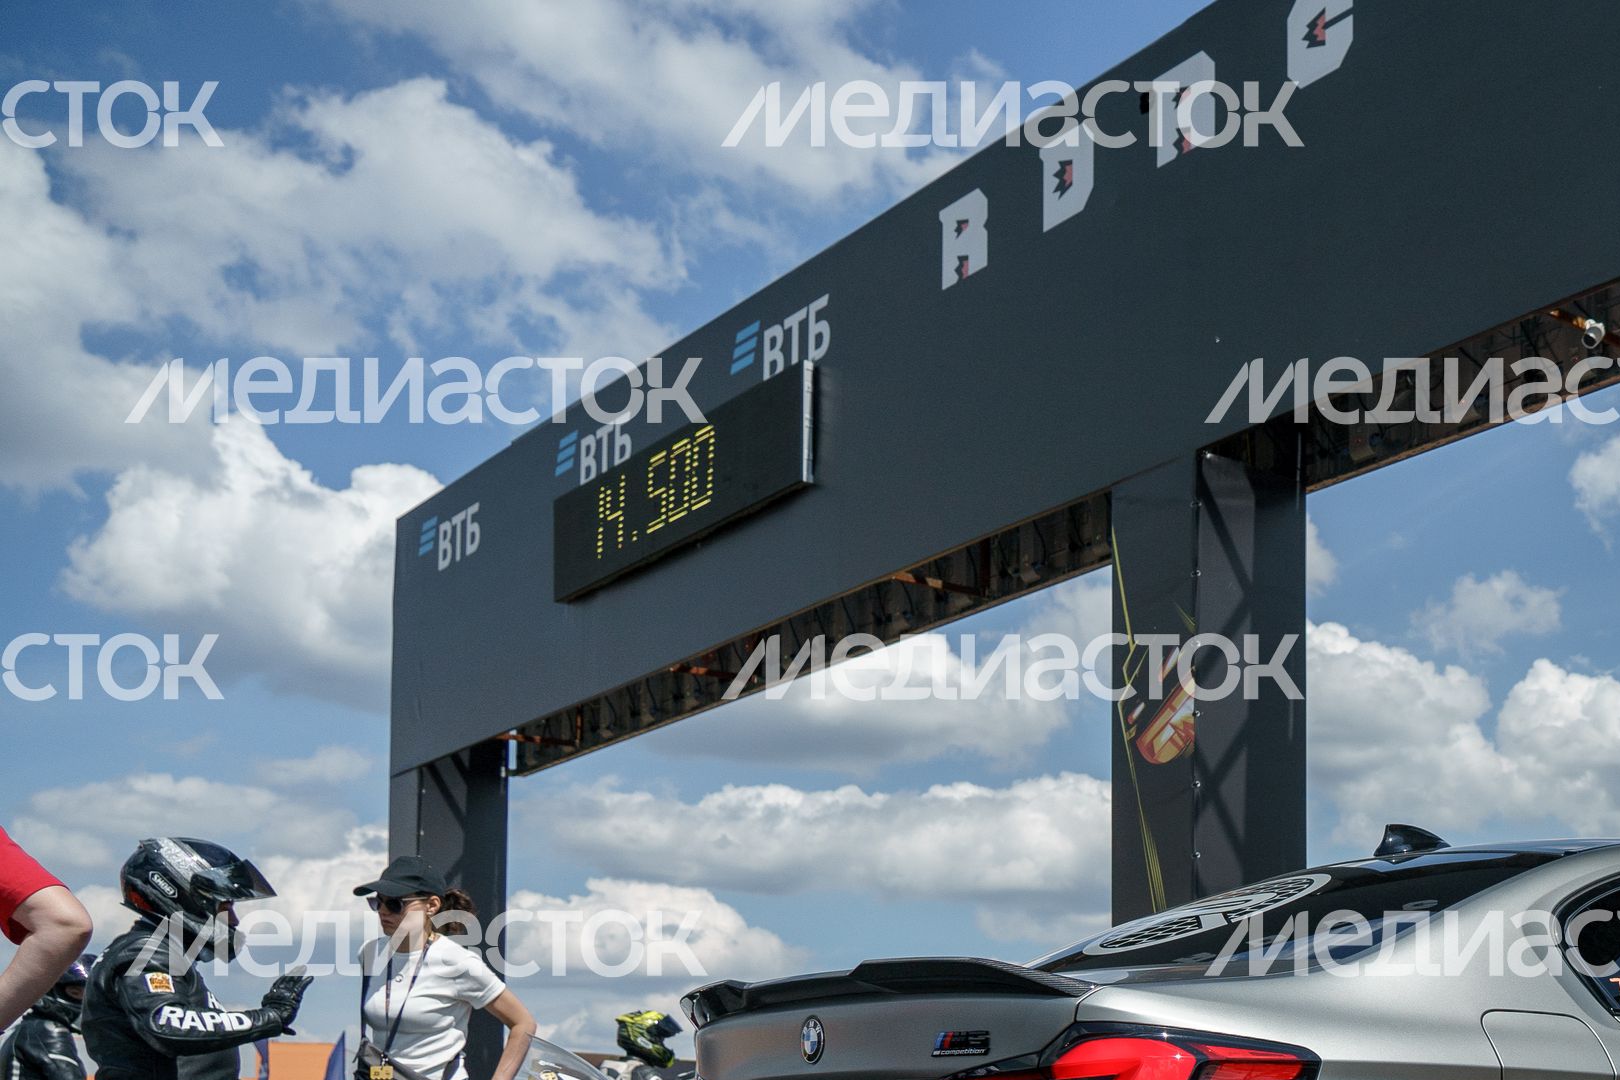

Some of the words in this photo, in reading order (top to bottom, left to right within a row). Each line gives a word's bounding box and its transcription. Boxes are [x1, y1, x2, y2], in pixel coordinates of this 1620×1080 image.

[763, 293, 831, 380] ВТБ
[580, 411, 632, 486] ВТБ
[438, 502, 480, 571] ВТБ
[151, 873, 176, 897] SHOEI
[158, 1004, 253, 1032] RAPID
